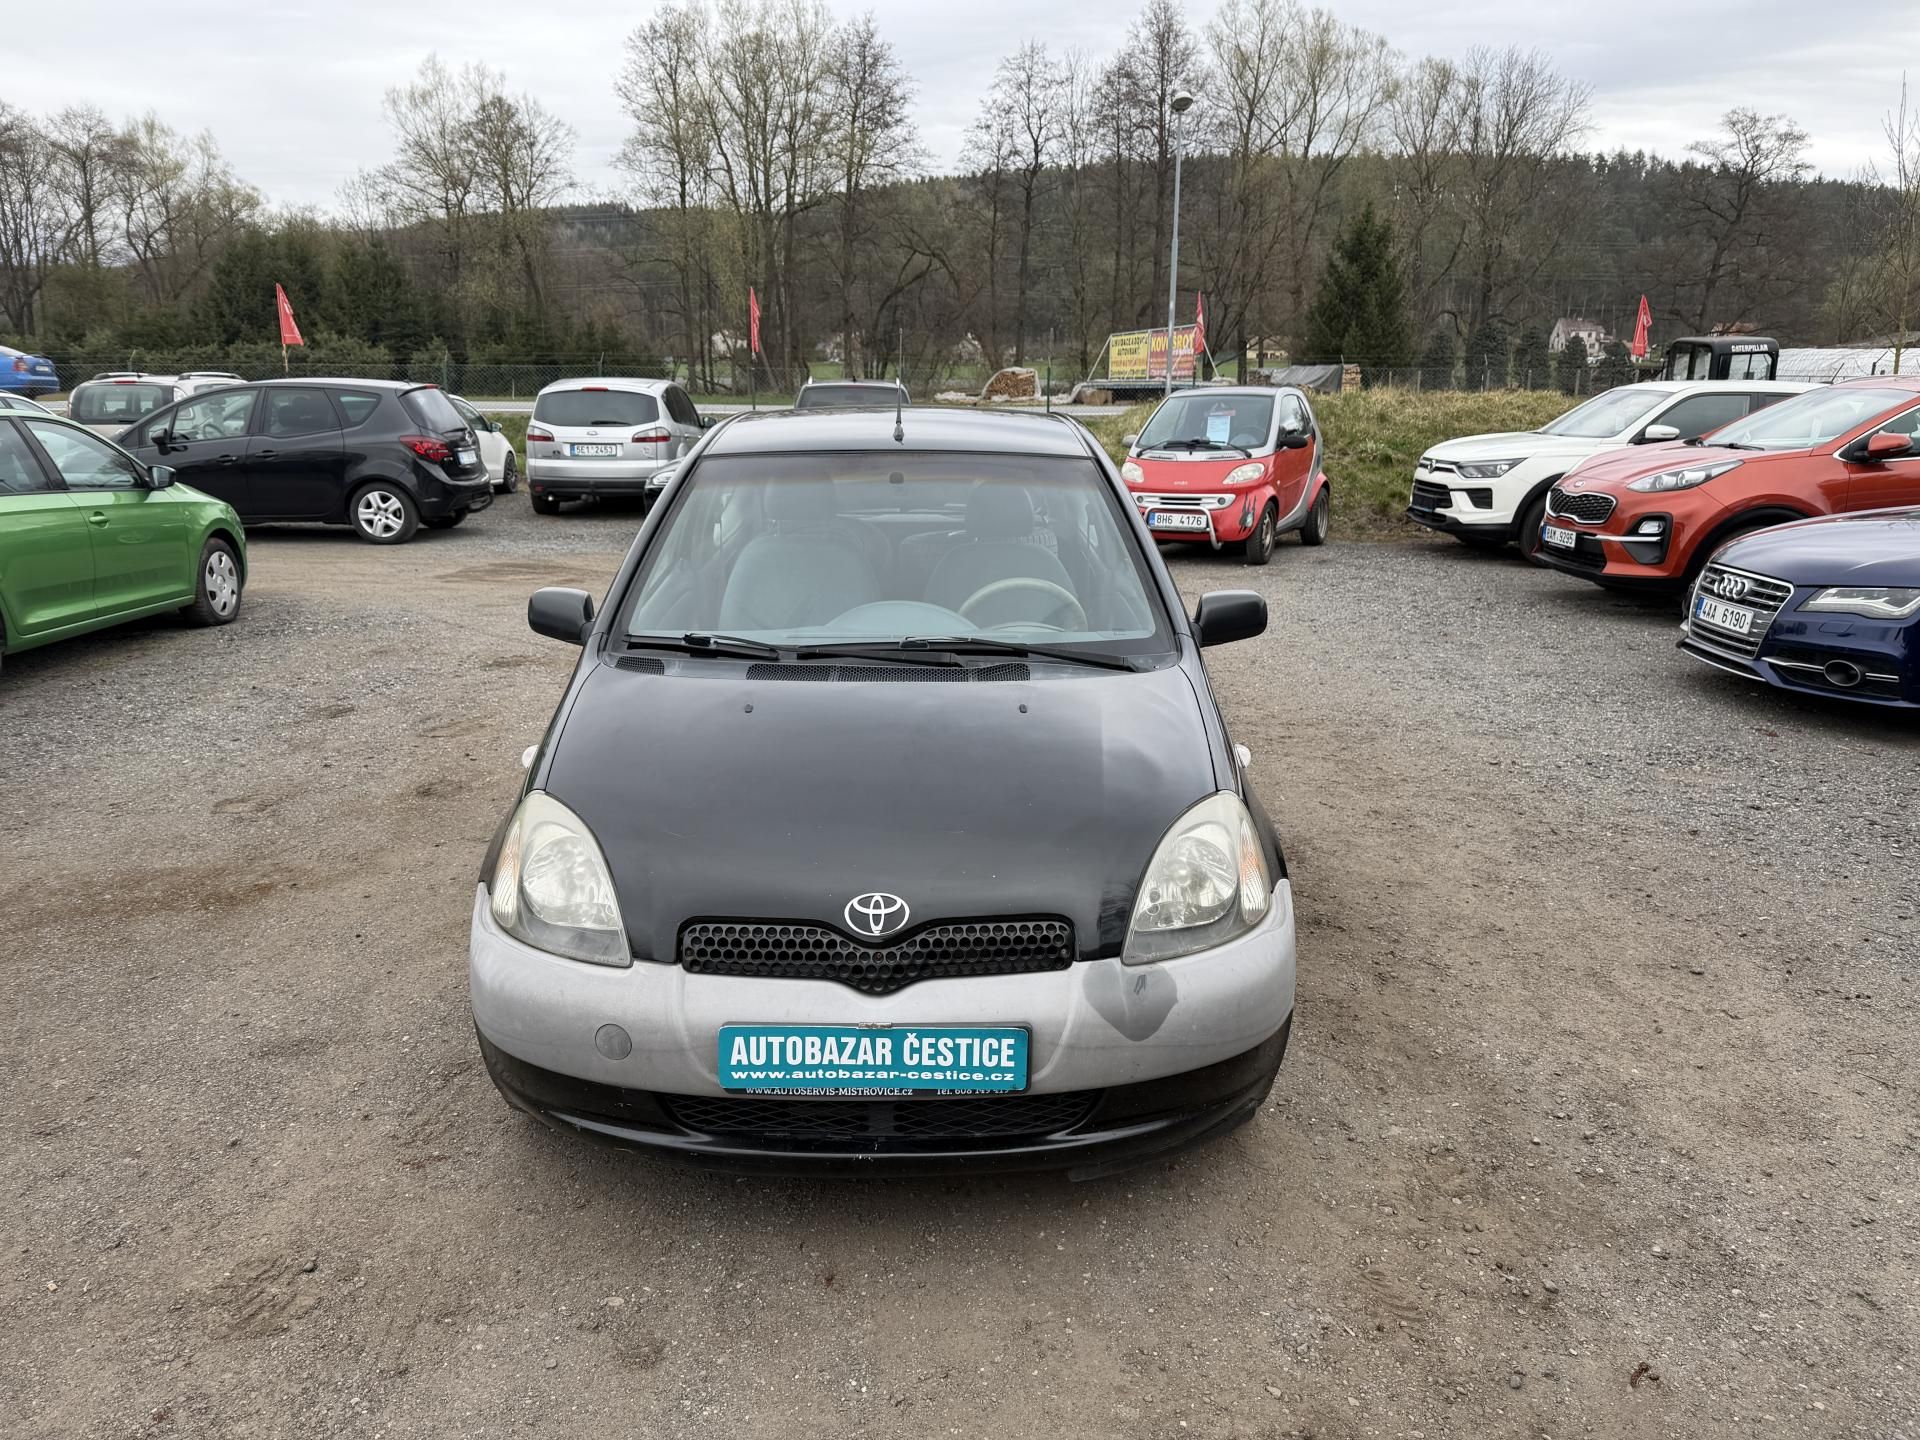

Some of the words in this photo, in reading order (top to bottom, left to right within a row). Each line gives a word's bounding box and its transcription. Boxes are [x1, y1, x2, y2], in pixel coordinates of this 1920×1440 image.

[1731, 344, 1768, 352] CATERPILLAR
[576, 444, 590, 453] 5E1
[595, 444, 613, 453] 2453
[1156, 514, 1173, 525] 8H6
[1179, 515, 1202, 526] 4176
[1559, 530, 1574, 545] 9295
[1702, 601, 1717, 621] 4AA
[1721, 603, 1747, 629] 6190
[730, 1036, 892, 1066] AUTOBAZAR
[903, 1033, 1015, 1067] ČESTICE
[730, 1069, 1014, 1081] www.autobazar-cestice.cz
